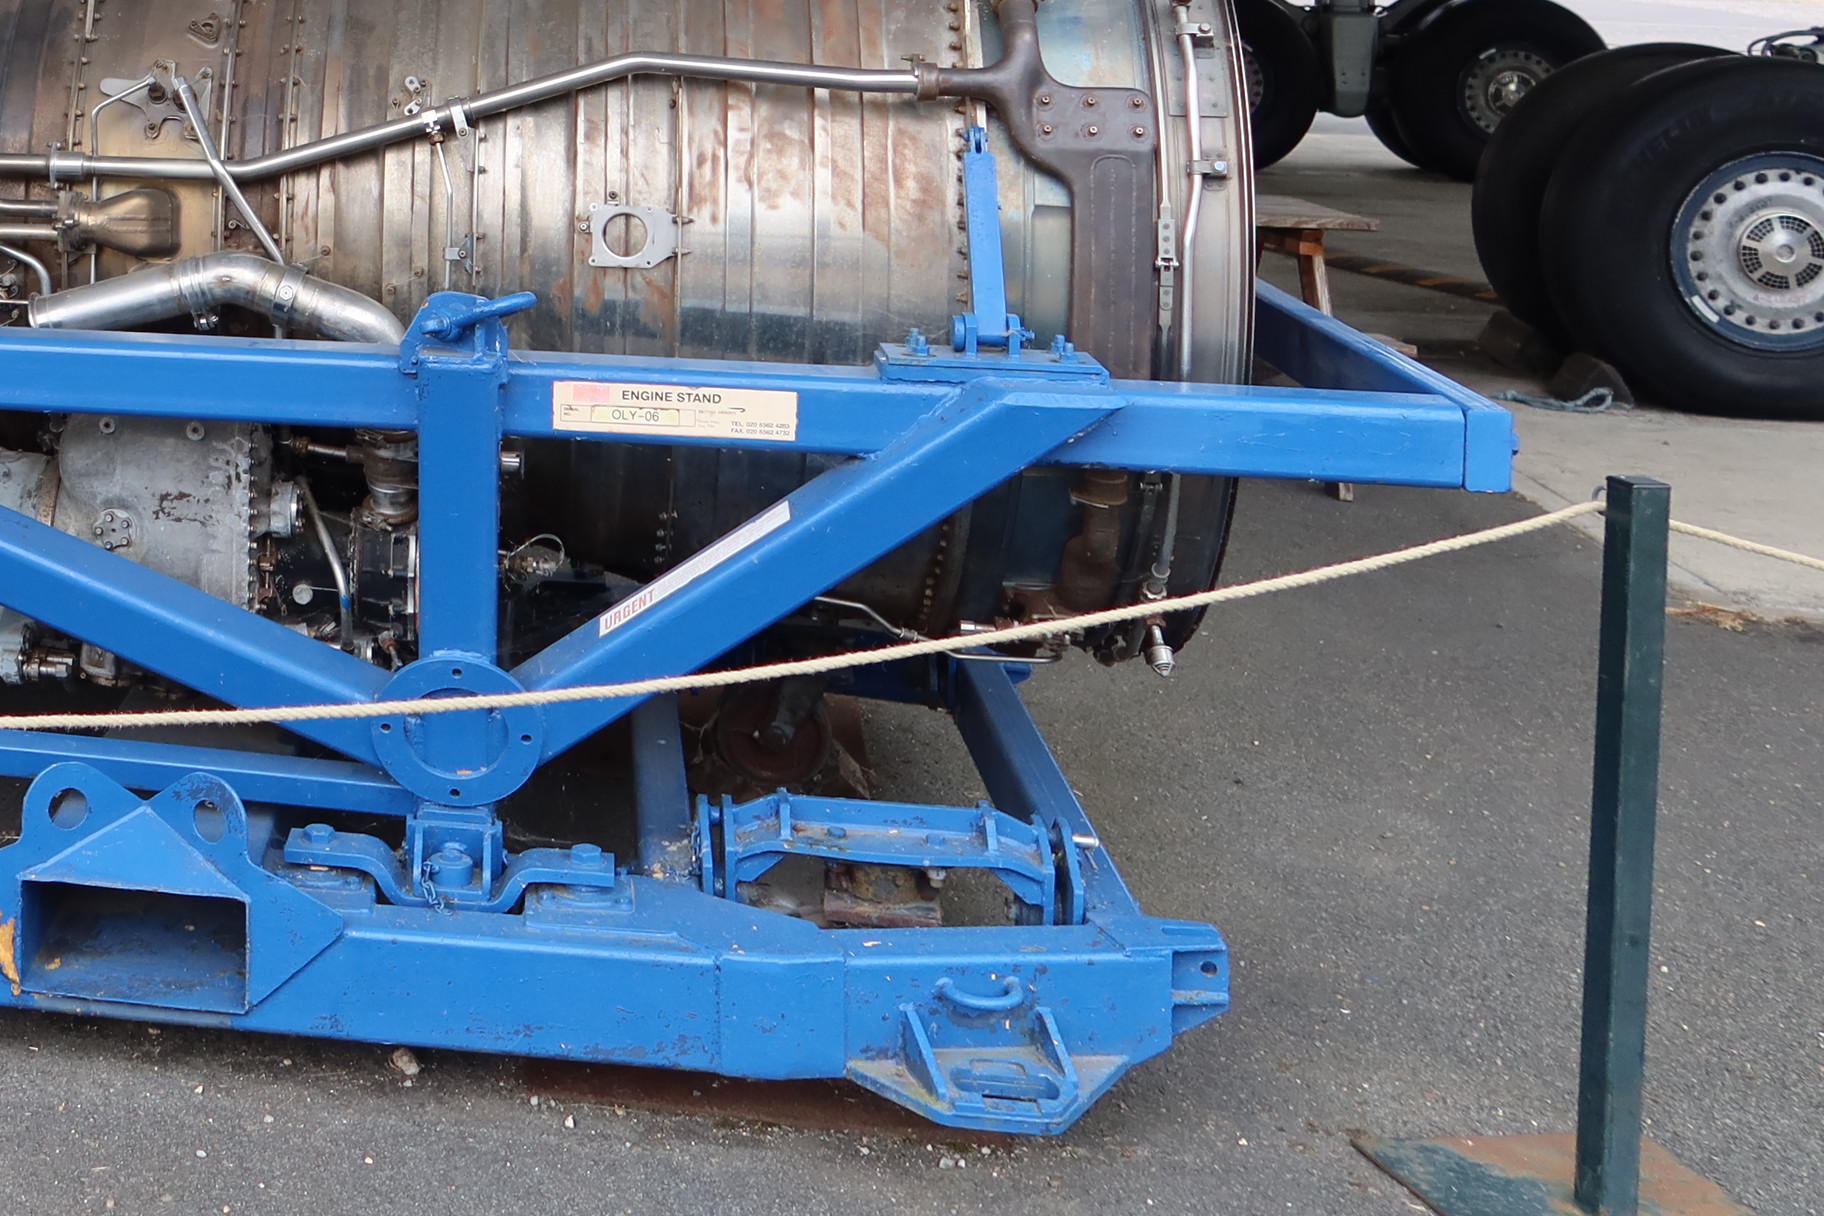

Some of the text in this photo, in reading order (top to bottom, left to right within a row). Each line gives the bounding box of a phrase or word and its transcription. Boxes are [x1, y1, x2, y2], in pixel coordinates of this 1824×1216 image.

[622, 389, 722, 405] ENGINE STAND
[611, 408, 660, 423] OLY-06
[604, 588, 655, 630] URGENT
